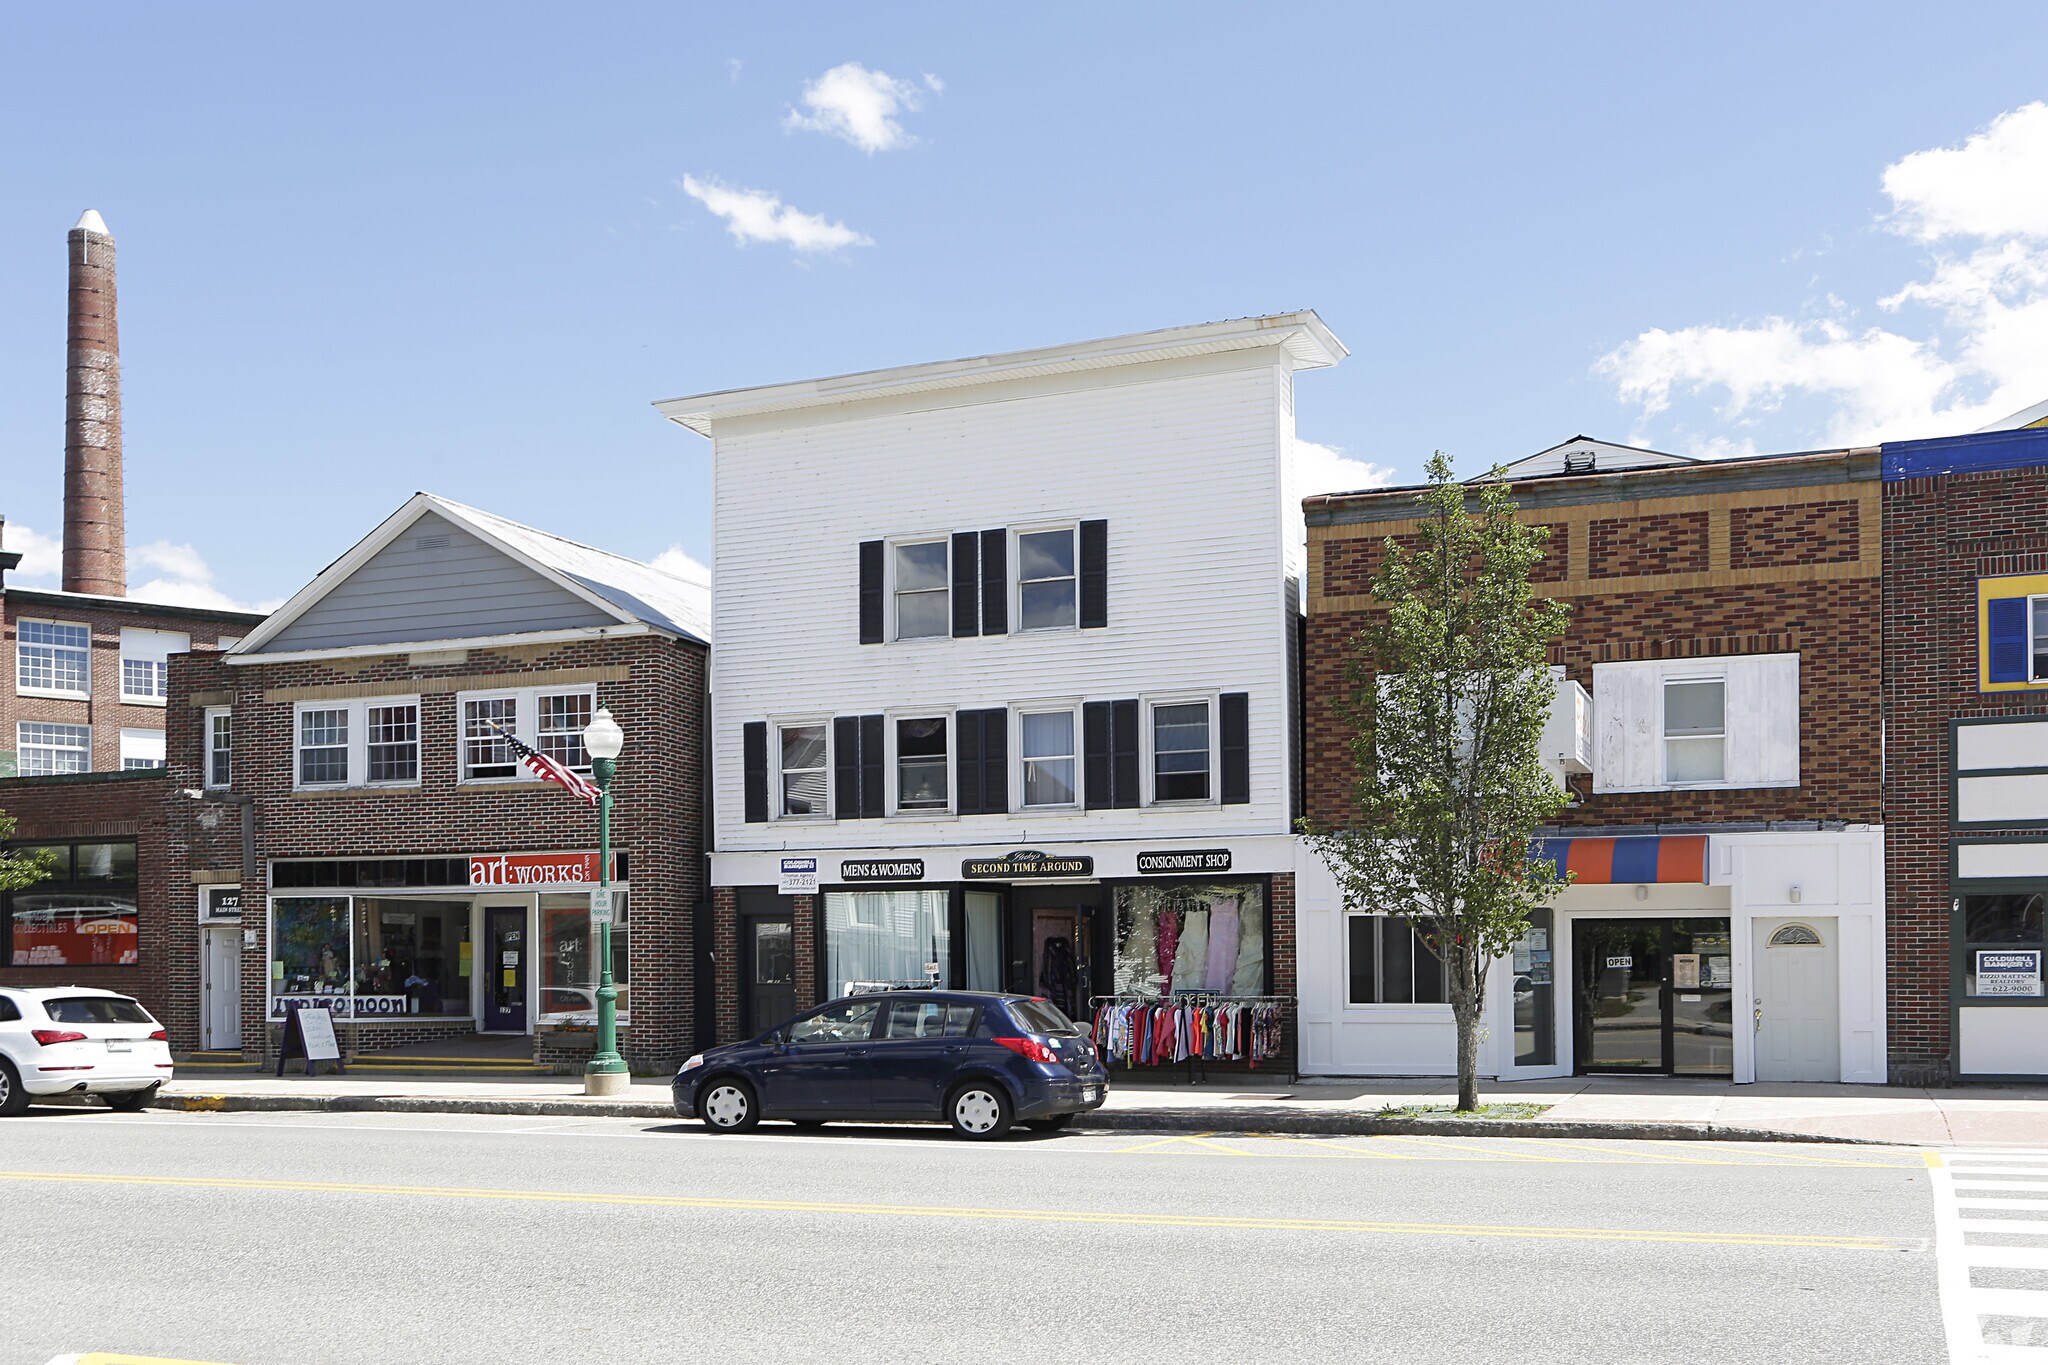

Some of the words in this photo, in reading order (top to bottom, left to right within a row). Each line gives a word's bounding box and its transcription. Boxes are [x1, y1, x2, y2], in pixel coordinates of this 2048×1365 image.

[1140, 855, 1203, 868] CONSIGNMENT
[1206, 854, 1229, 867] SHOP
[879, 862, 921, 875] WOMENS
[971, 864, 1010, 873] SECOND
[1012, 863, 1037, 872] TIME
[1039, 861, 1083, 871] AROUND
[221, 897, 239, 906] 127
[13, 923, 68, 933] COLLECTIBLES
[84, 924, 131, 933] OPEN
[1608, 958, 1631, 967] OPEN
